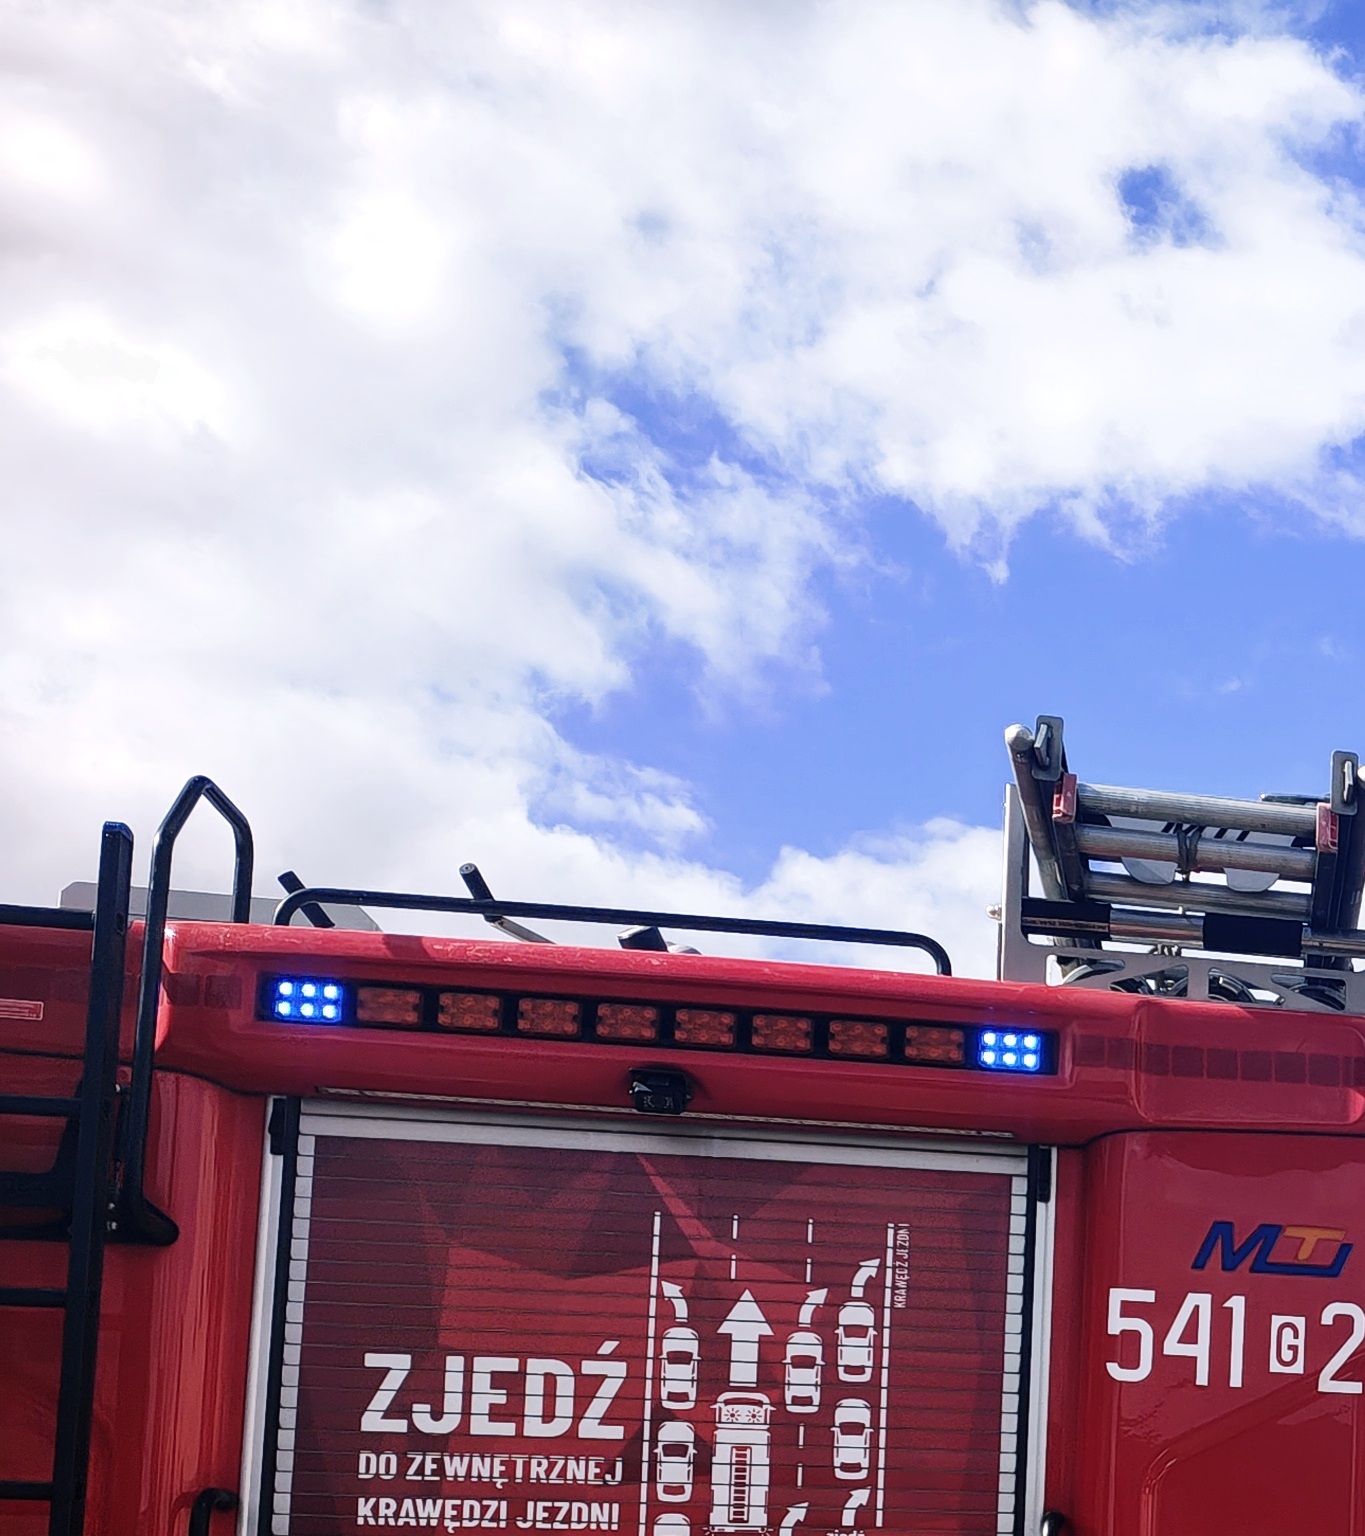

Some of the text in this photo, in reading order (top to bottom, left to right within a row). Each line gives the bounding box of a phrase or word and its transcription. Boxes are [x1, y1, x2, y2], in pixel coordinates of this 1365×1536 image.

[1105, 1287, 1246, 1388] 541
[1274, 1320, 1301, 1368] G
[360, 1340, 628, 1440] ZJEDŹ
[357, 1450, 624, 1489] DO ZEWNĘTRZNEJ
[356, 1497, 620, 1534] KRAWĘDZI JEZDNI
